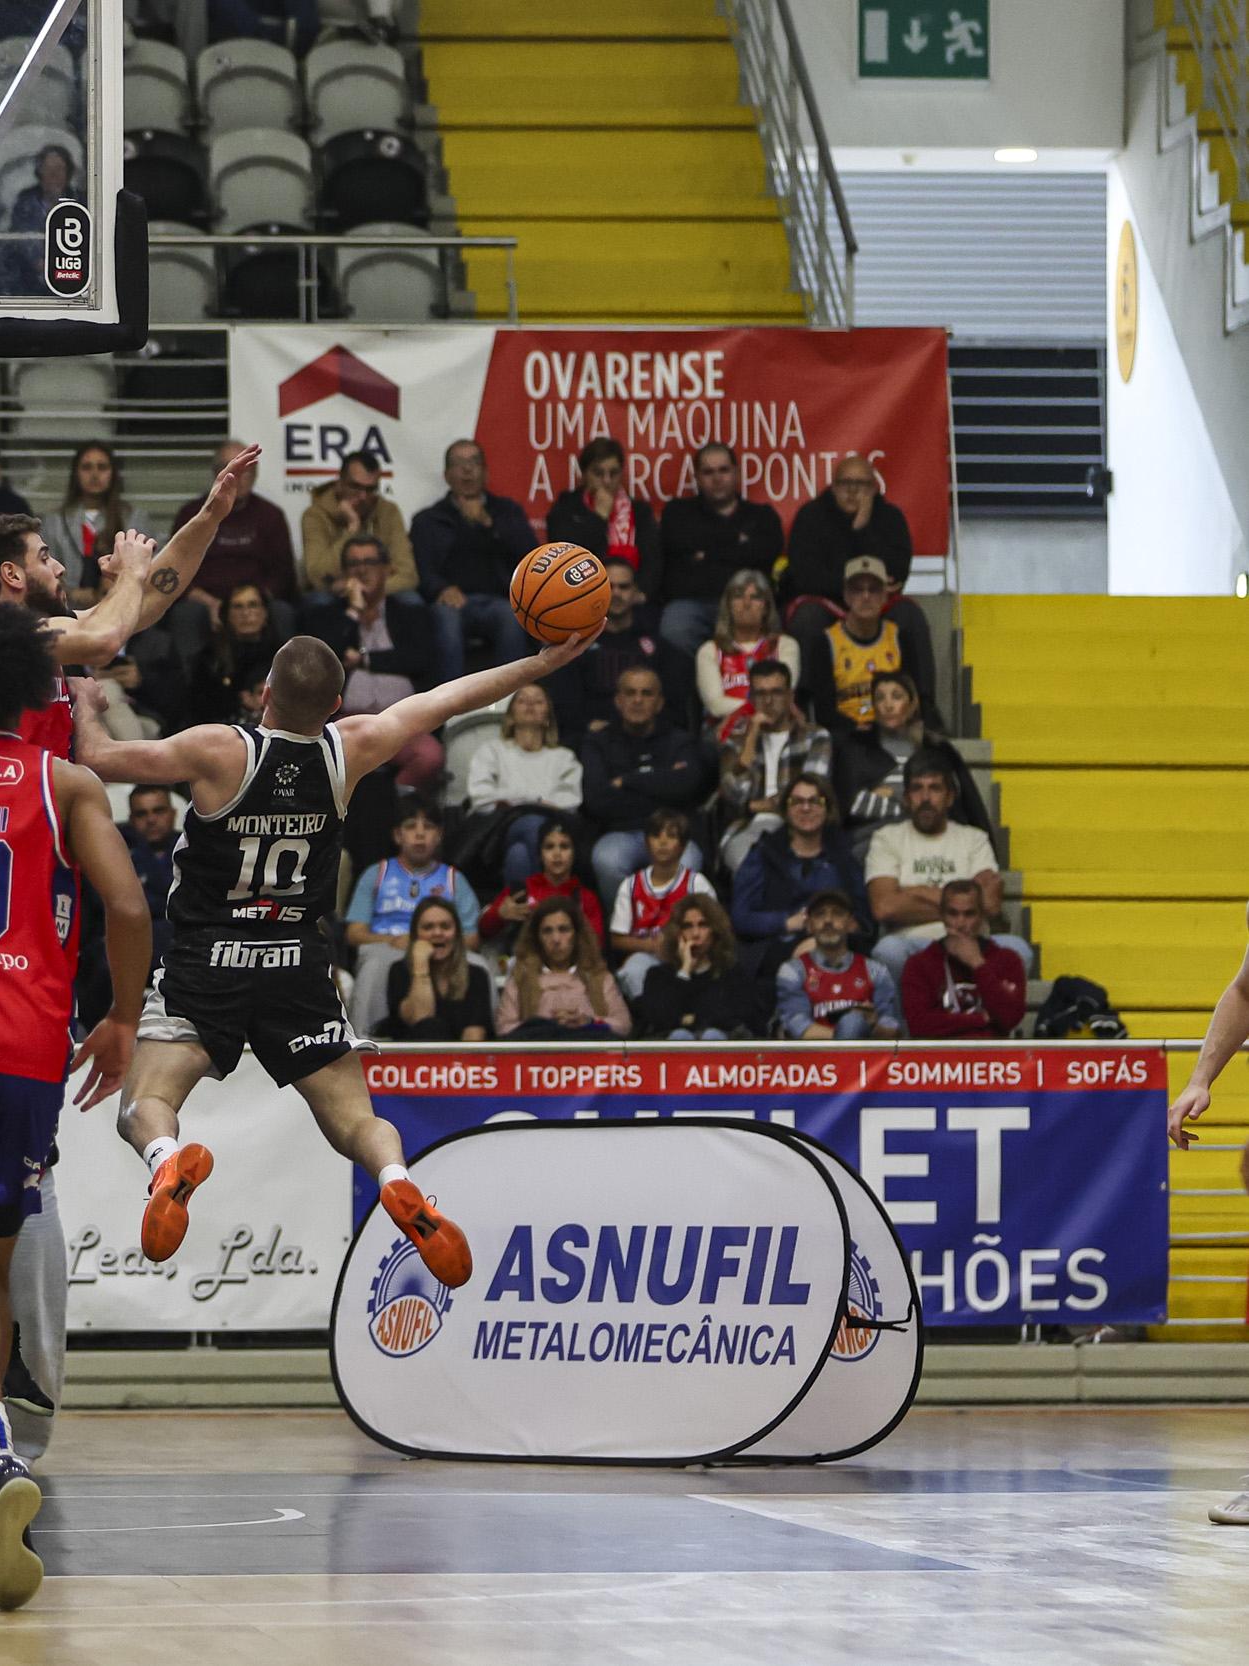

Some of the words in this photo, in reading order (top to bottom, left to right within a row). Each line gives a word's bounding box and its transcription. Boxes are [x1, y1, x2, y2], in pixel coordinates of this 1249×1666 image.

[524, 350, 725, 399] OVARENSE
[285, 424, 393, 464] ERA
[529, 401, 611, 450] UMA
[627, 400, 806, 449] MÁQUINA
[529, 453, 553, 500] A
[531, 544, 577, 573] Wilson
[273, 788, 295, 797] OVAR
[227, 813, 327, 836] MONTEIRO
[226, 836, 311, 900] 10
[209, 939, 300, 968] fibran
[367, 1062, 498, 1090] COLCHÕES
[528, 1065, 642, 1089] TOPPERS
[684, 1063, 837, 1088] ALMOFADAS
[887, 1061, 1021, 1086] SOMMIERS
[1066, 1055, 1147, 1084] SOFÁS
[190, 1223, 318, 1301] Lda.
[484, 1224, 811, 1305] ASNUFIL
[912, 1233, 1109, 1312] HÕES
[473, 1315, 796, 1366] METALOMECÂNICA
